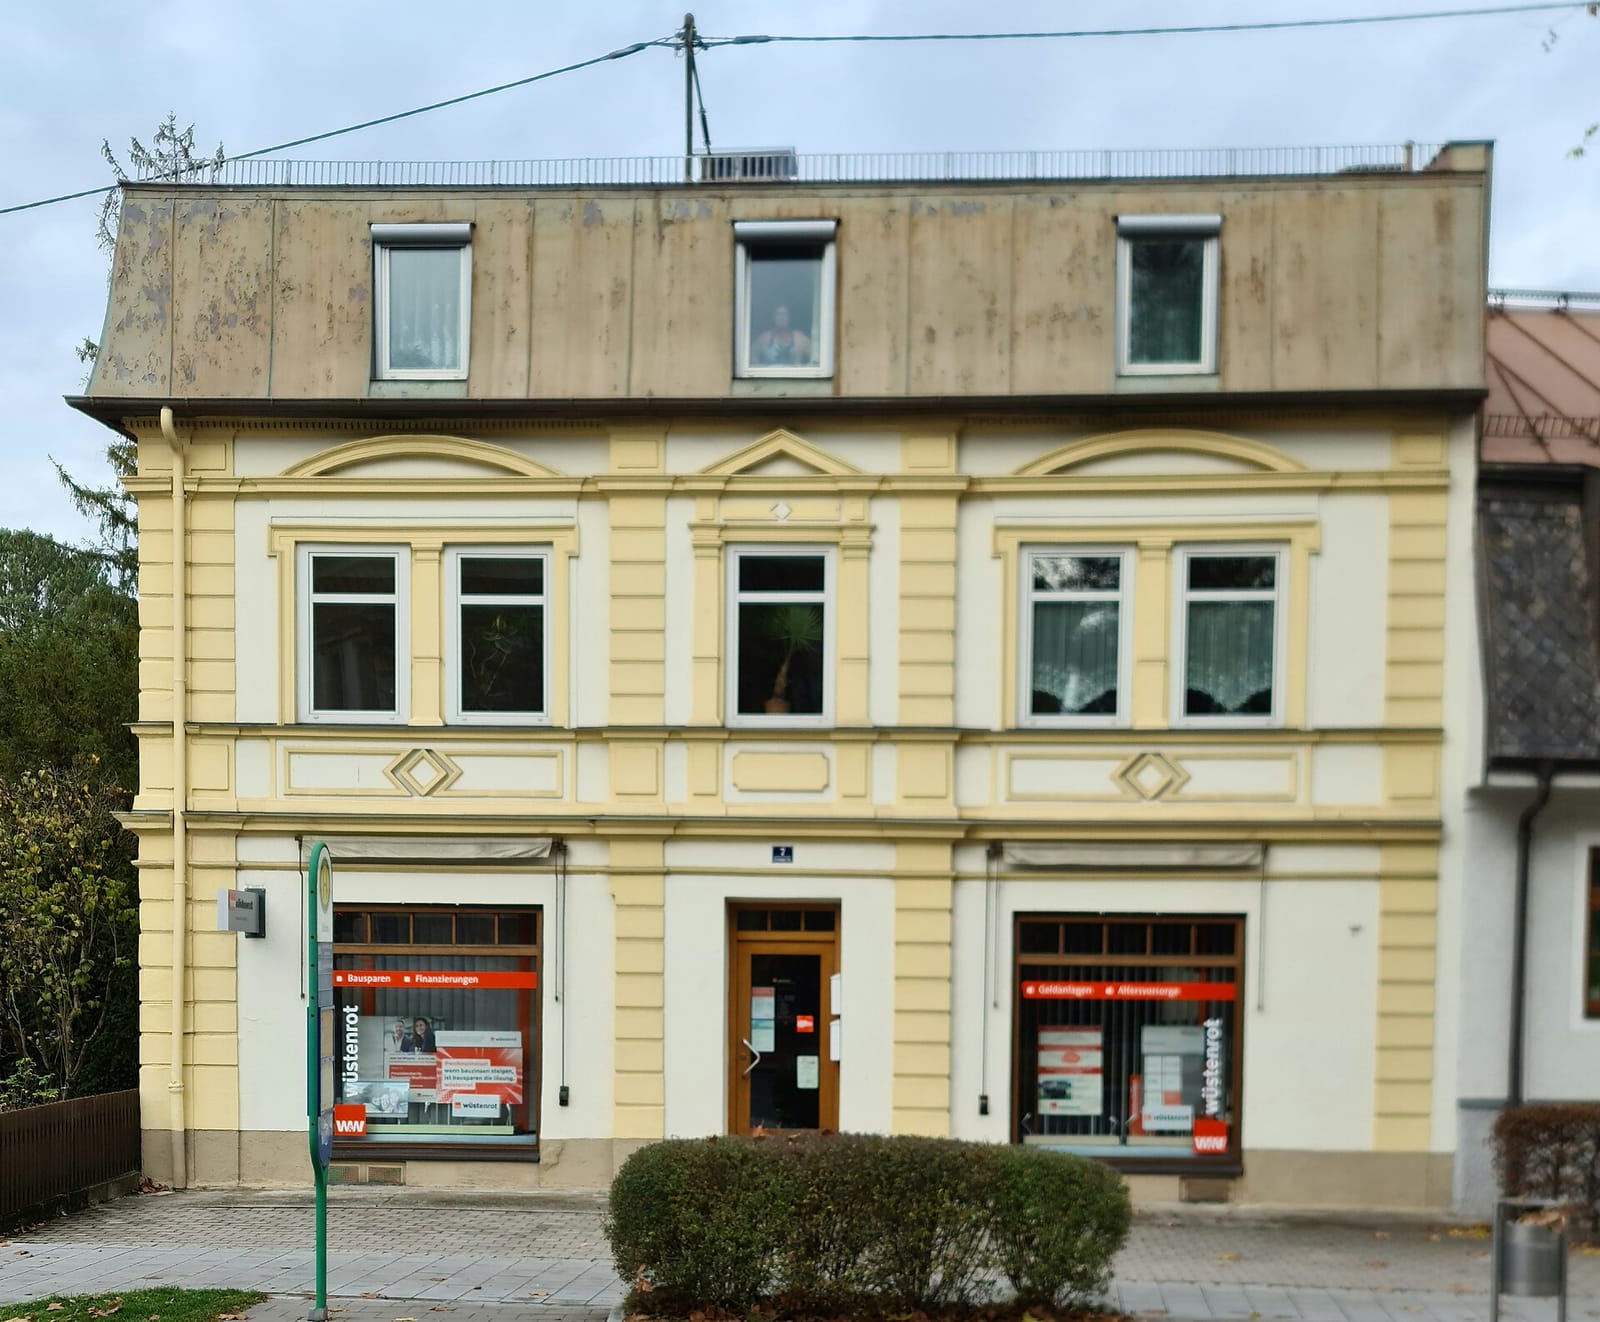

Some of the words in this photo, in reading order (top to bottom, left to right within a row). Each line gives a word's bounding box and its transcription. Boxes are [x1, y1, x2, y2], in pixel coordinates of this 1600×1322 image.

[347, 974, 391, 984] Bausparen
[415, 974, 479, 985] Finanzierungen
[1038, 985, 1092, 997] Geldanlagen
[1117, 986, 1180, 998] Altersvorsorge
[342, 1005, 359, 1097] wüstenrot
[1201, 1018, 1222, 1114] wüstenrot
[462, 1102, 498, 1110] wüstenrot
